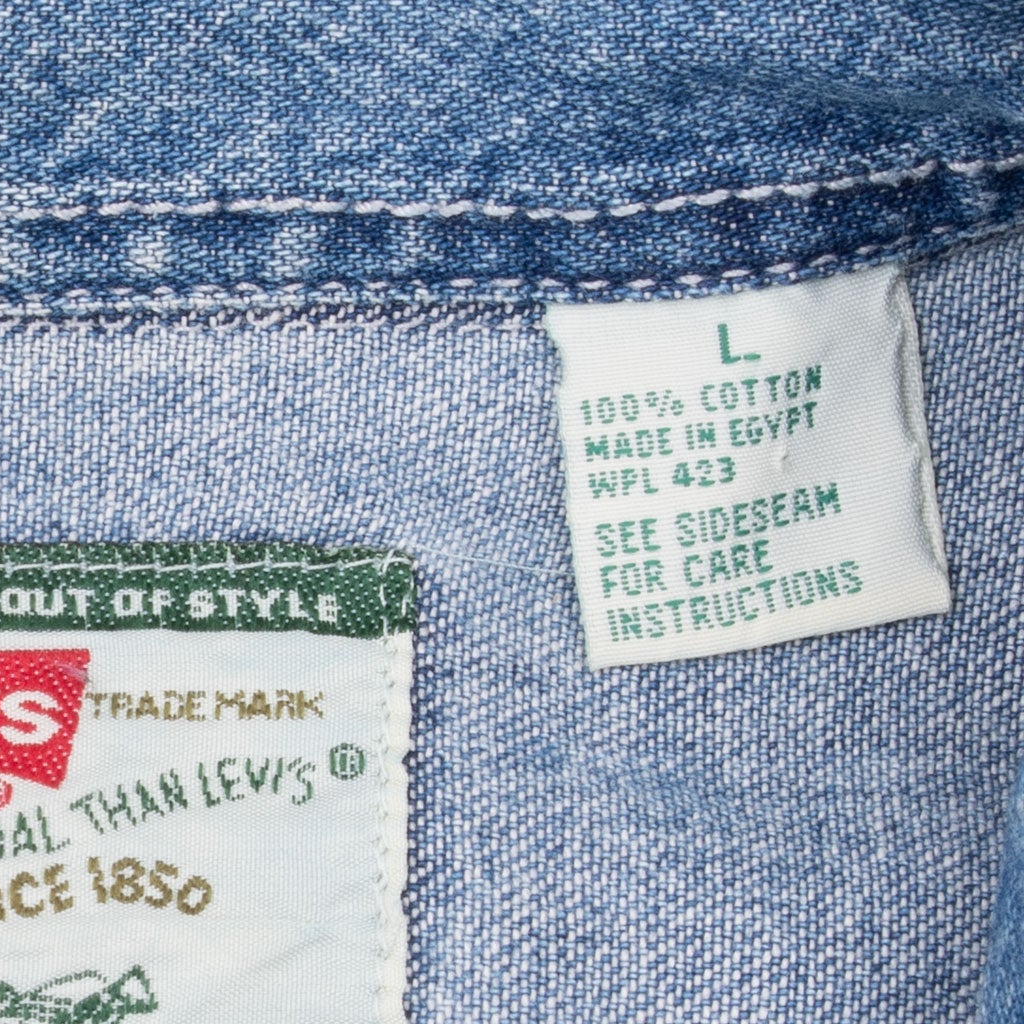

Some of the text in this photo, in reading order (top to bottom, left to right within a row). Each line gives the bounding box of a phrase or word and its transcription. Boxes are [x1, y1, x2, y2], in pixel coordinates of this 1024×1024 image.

[717, 323, 761, 365] L
[580, 365, 823, 426] 100% COTTON
[584, 401, 818, 463] MADE IN EGYPT
[588, 456, 737, 500] WPL 423
[594, 482, 842, 558] SEE SIDESEAM
[599, 539, 774, 599] FOR CARE
[0, 588, 91, 617] OUT
[111, 588, 176, 617] OF
[189, 588, 339, 621] STYLE
[606, 560, 864, 643] INSTRUCTIONS
[70, 768, 188, 834] THAN
[87, 857, 214, 916] 1850
